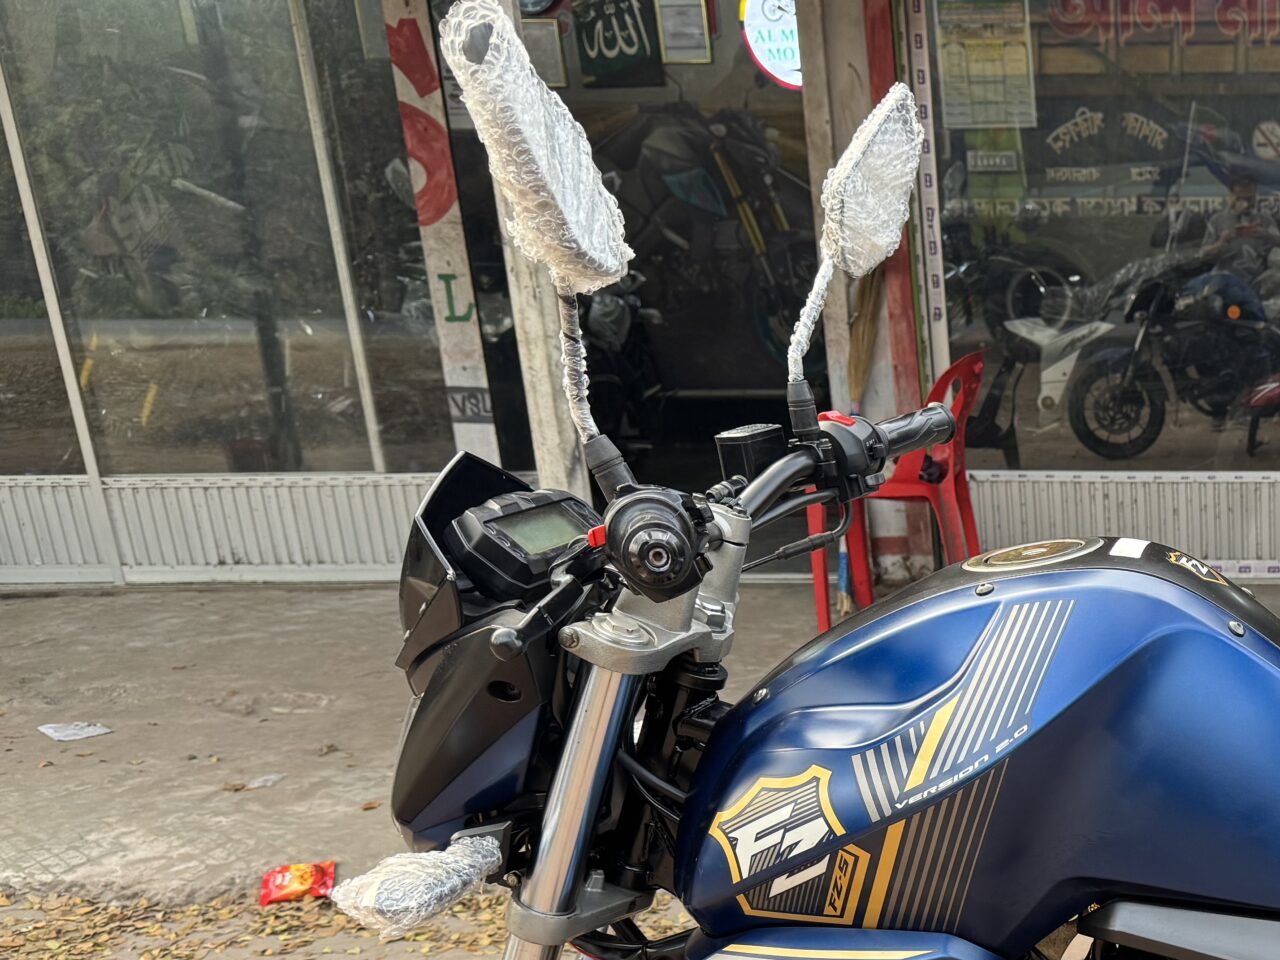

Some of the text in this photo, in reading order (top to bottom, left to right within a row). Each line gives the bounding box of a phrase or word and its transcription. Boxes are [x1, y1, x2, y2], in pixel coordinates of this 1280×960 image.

[438, 273, 474, 323] L
[895, 724, 1029, 809] VERSION 2.0
